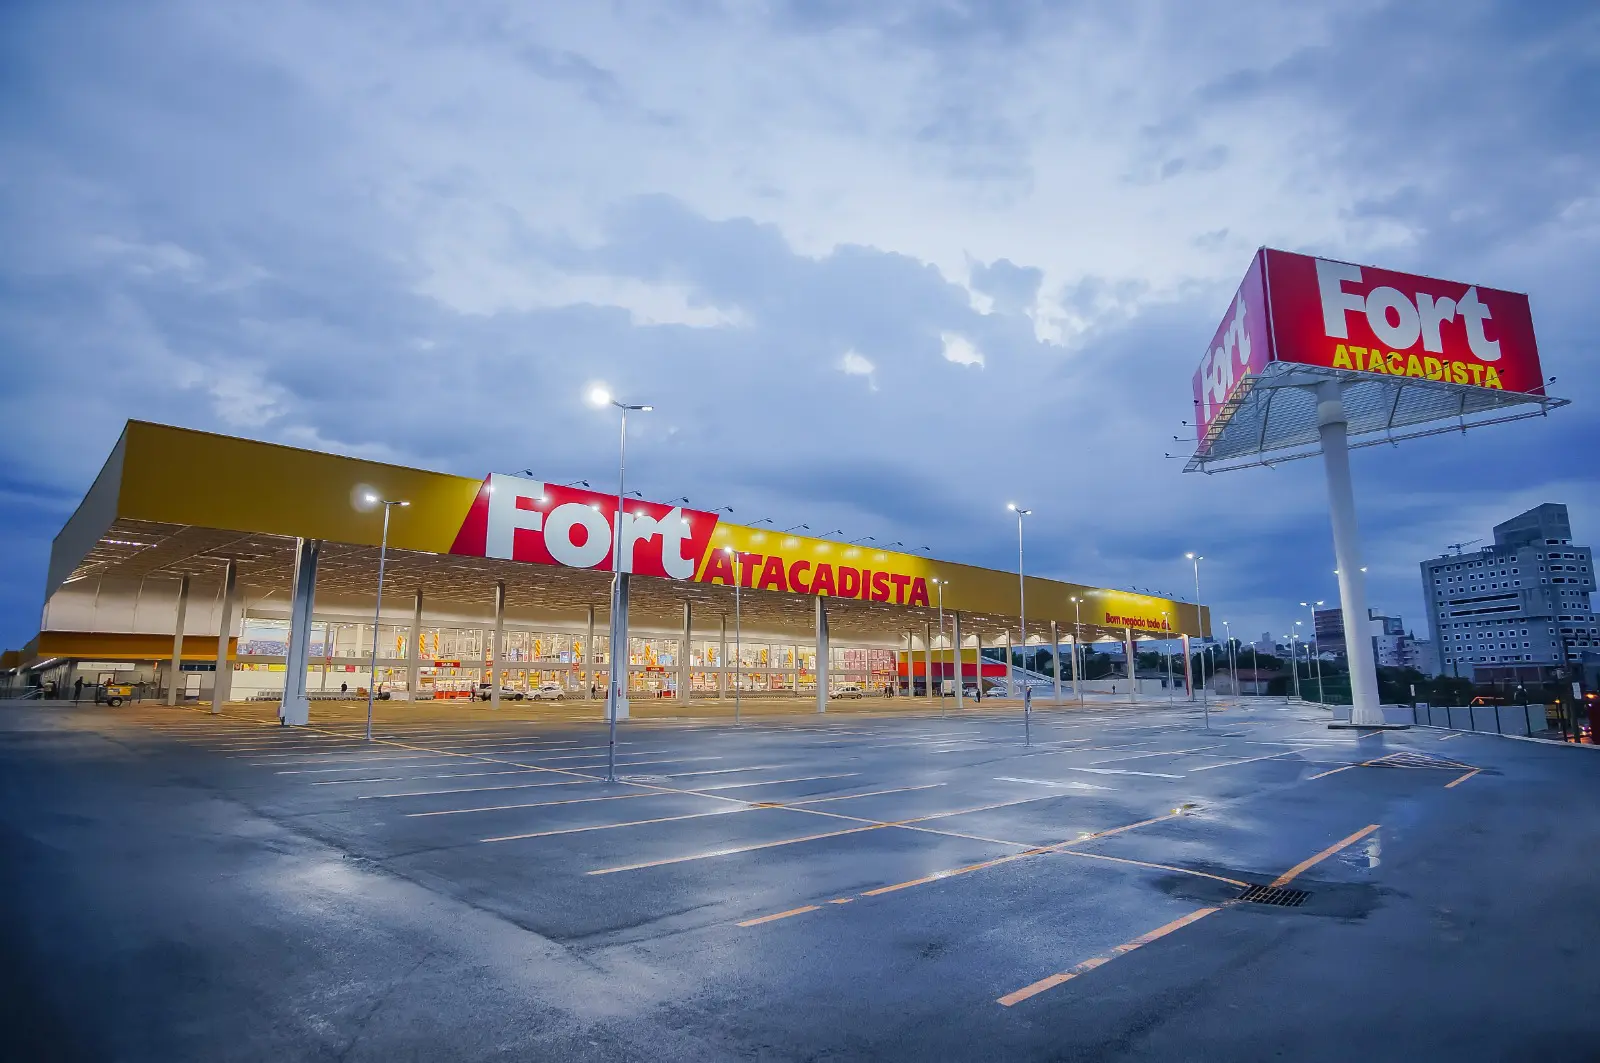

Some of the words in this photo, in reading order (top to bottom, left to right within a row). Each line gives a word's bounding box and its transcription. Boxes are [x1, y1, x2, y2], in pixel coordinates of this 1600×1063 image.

[1201, 289, 1251, 424] Fort
[1315, 258, 1502, 362] Fort
[1332, 344, 1503, 390] ATACADISTA
[485, 472, 695, 580] Fort
[700, 547, 930, 607] ATACADISTA
[1105, 612, 1120, 624] Bom
[1147, 618, 1160, 629] todo
[1161, 619, 1171, 630] da.
